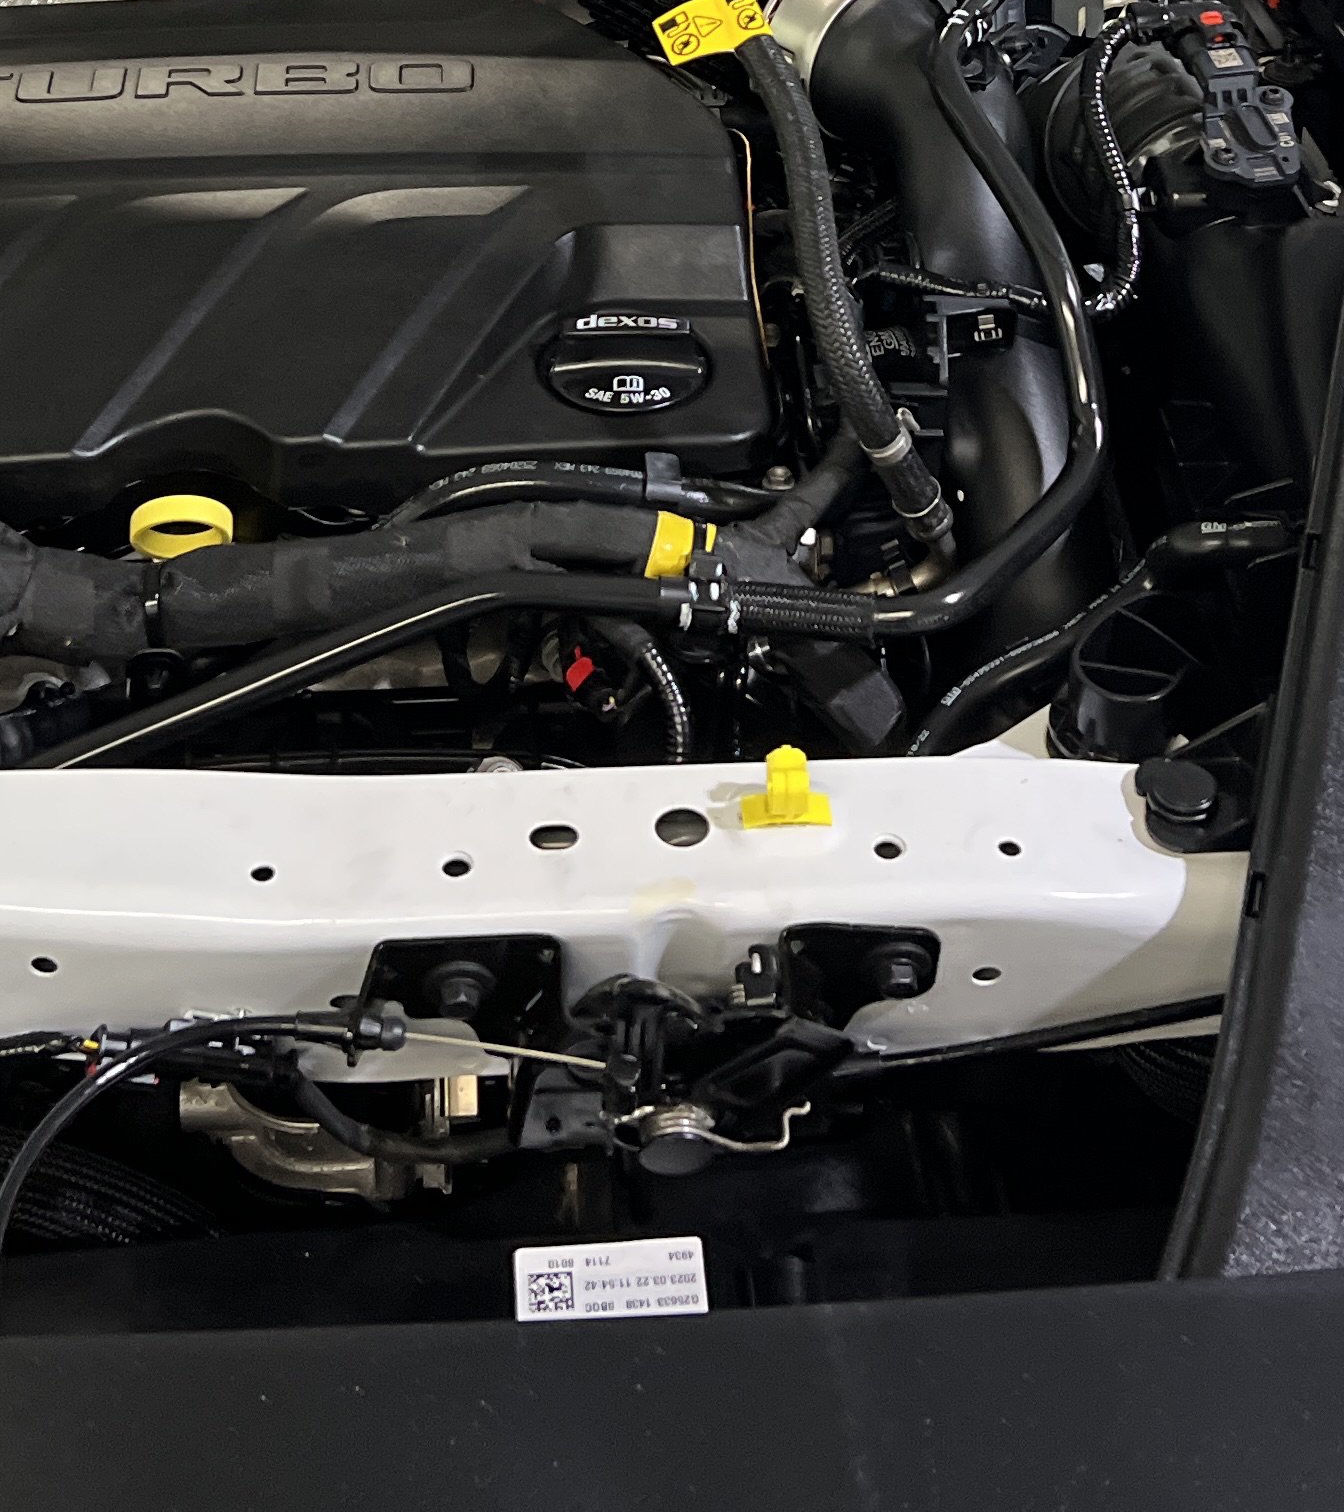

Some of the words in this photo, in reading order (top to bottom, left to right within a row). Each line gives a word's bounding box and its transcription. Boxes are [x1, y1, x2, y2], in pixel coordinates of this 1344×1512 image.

[575, 313, 679, 331] dexos
[584, 387, 615, 404] SAE
[619, 386, 672, 405] 5W-30
[635, 1271, 698, 1287] 2023.03.22
